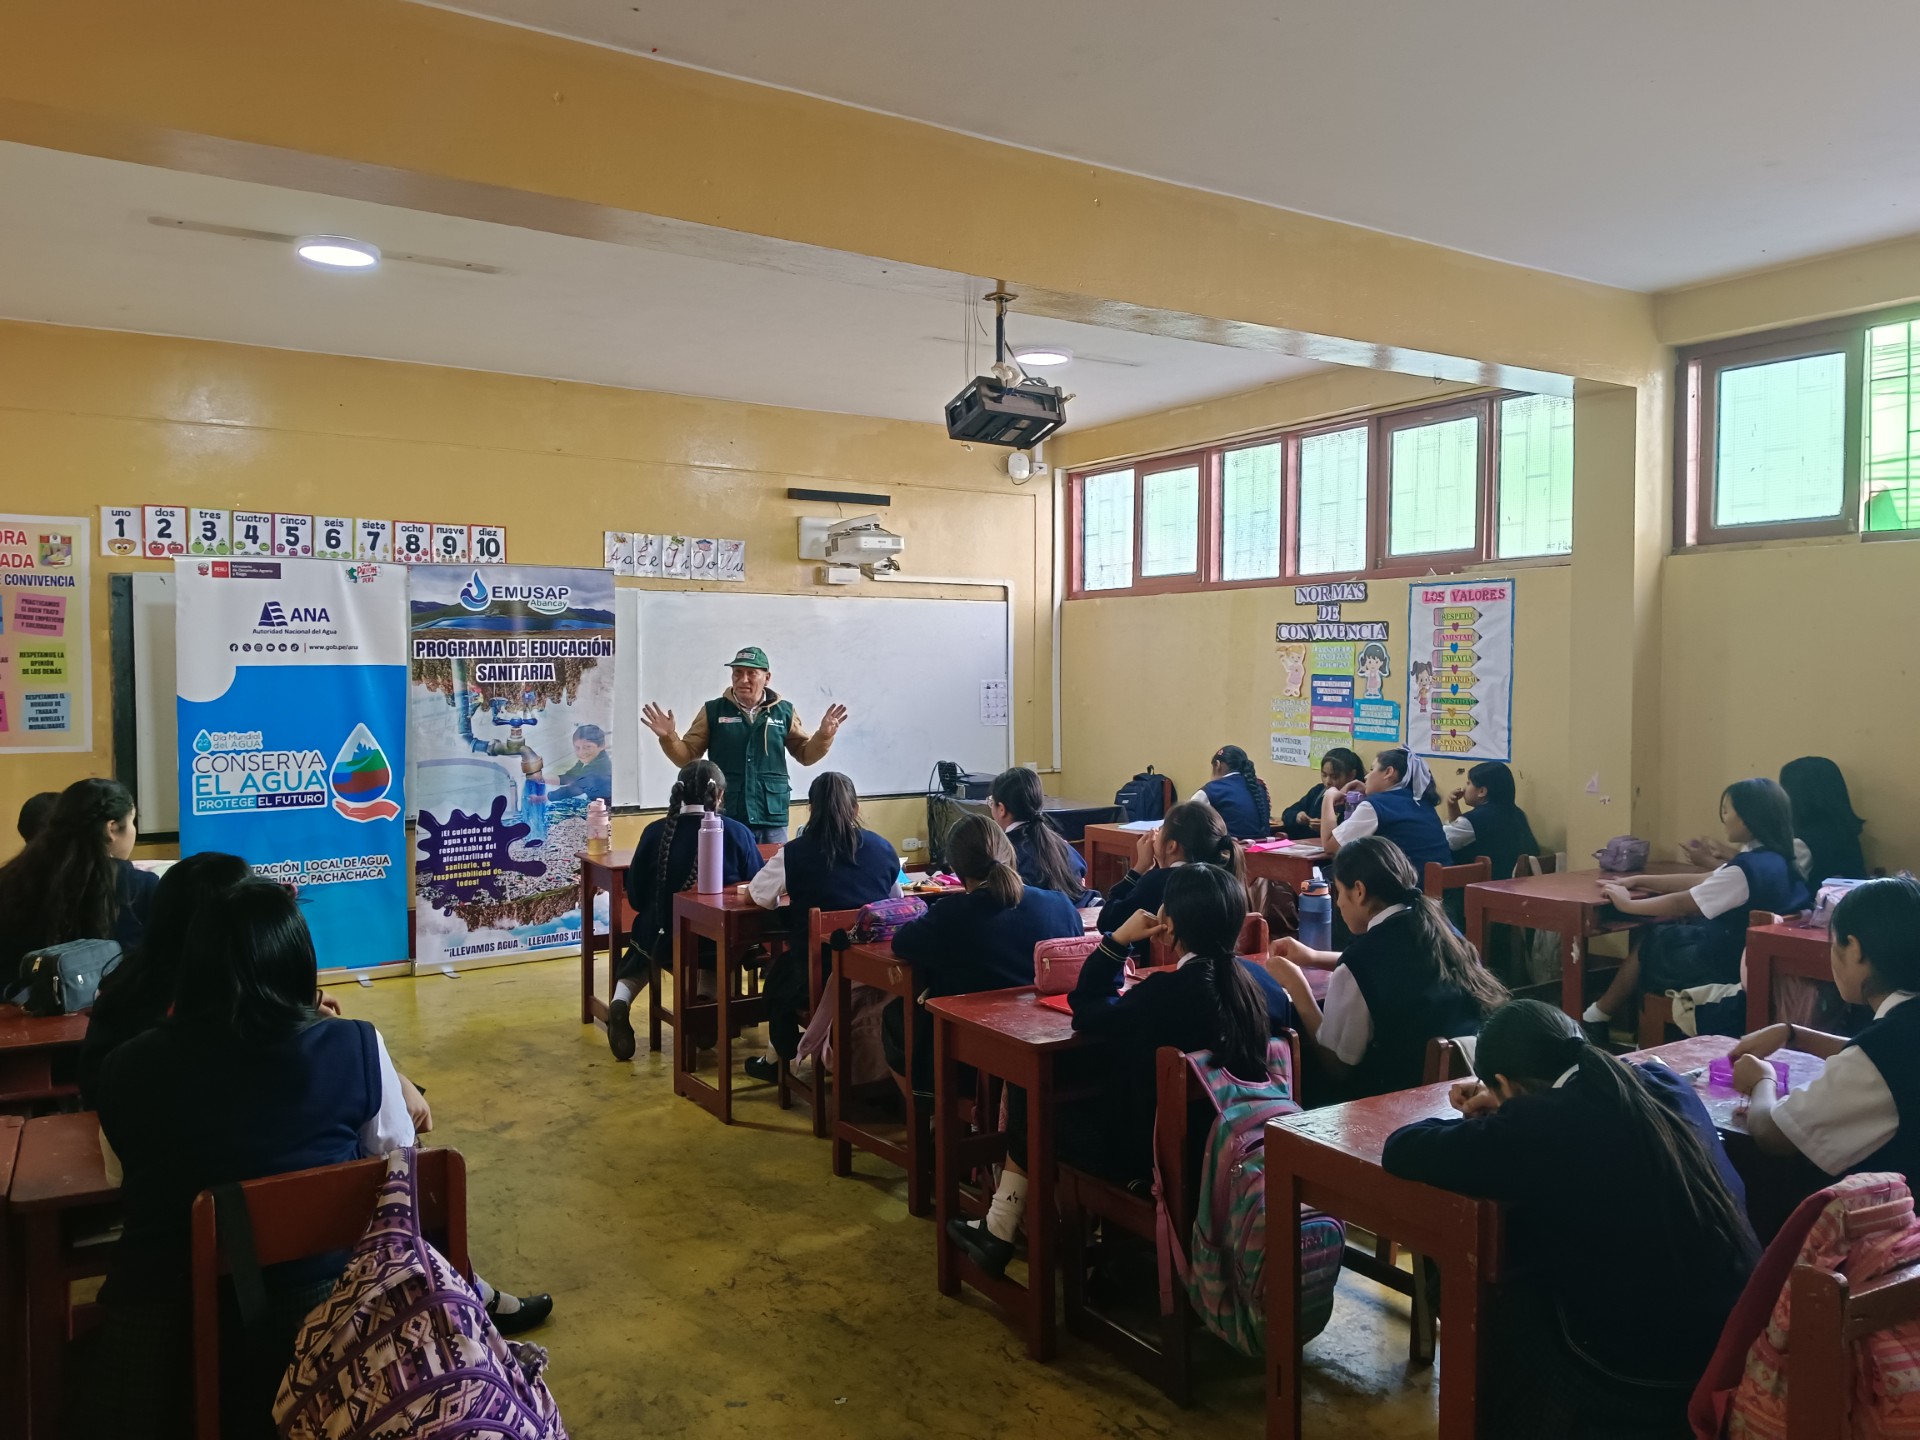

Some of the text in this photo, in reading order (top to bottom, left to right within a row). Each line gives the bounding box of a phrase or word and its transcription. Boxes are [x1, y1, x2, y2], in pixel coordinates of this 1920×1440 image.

[155, 508, 175, 517] dos
[200, 510, 220, 520] tres
[236, 514, 270, 524] cuatro
[115, 518, 125, 537] 1
[157, 518, 172, 538] 2
[280, 516, 306, 526] cinco
[324, 519, 344, 527] seis
[362, 520, 386, 530] siete
[401, 524, 424, 532] ocho
[202, 521, 216, 541] 3
[244, 524, 259, 544] 4
[286, 526, 300, 546] 5
[436, 526, 464, 535] nueve
[479, 528, 498, 536] diez
[326, 528, 341, 549] 6
[367, 531, 380, 551] 7
[406, 534, 420, 553] 8
[442, 536, 457, 554] 9
[476, 538, 500, 557] 10
[4, 574, 75, 587] CONVIVENCIA
[492, 586, 568, 600] EMUSAP
[1298, 584, 1364, 602] NORMAS
[1424, 588, 1506, 602] LOS VALORES
[530, 600, 568, 608] Abancay
[290, 608, 330, 622] ANA
[1319, 606, 1338, 620] DE
[1278, 624, 1387, 639] CONVIVENCIA
[1442, 634, 1472, 642] AMISTAD
[416, 636, 611, 658] PROGRAMA DE EDUCACIÓN
[478, 665, 554, 681] SANITARIA
[1433, 718, 1476, 726] TOLERANCIA
[228, 732, 260, 740] Mundial
[1272, 736, 1302, 745] MANTENER
[231, 740, 260, 748] AGUA
[1280, 747, 1302, 755] HIGIENE
[196, 752, 324, 774] CONSERVA
[196, 770, 324, 796] EL AGUA
[199, 794, 322, 810] PROTEGE EL FUTURO
[452, 828, 480, 836] cuidado
[439, 844, 483, 854] responsable
[444, 838, 461, 846] agua
[306, 859, 341, 872] LOCAL
[344, 858, 357, 868] DE
[360, 856, 390, 866] AGUA
[442, 852, 492, 862] alcantarillado
[310, 868, 384, 883] PACHACHACA
[434, 868, 492, 881] responsabilidad
[456, 878, 479, 888] todos!
[528, 932, 569, 946] LLEVAMOS
